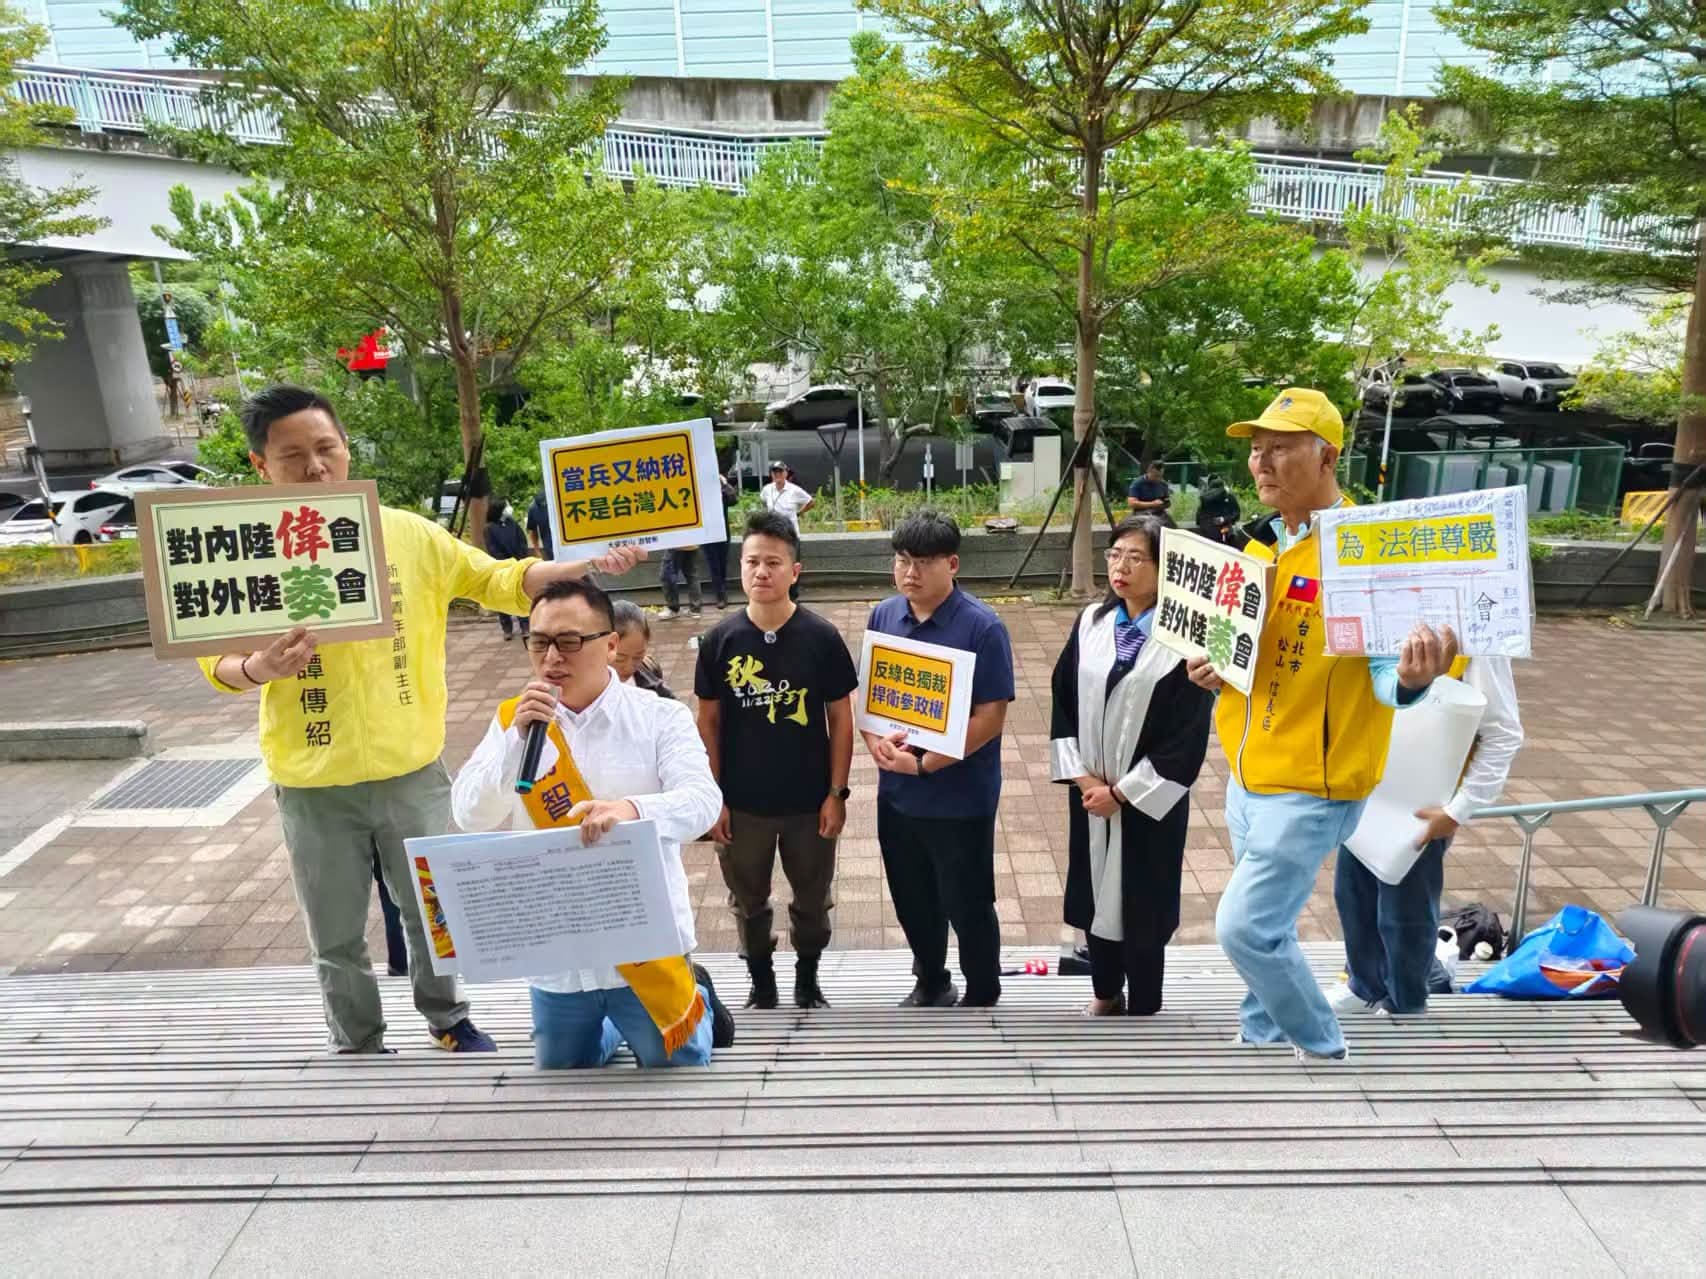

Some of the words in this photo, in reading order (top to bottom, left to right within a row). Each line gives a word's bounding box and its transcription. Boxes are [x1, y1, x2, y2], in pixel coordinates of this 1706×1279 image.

[562, 453, 687, 492] 當兵又納稅
[565, 488, 691, 523] 不是台灣人?
[166, 505, 361, 566] 對內陸偉會
[1338, 531, 1365, 560] 為
[1379, 521, 1497, 557] 法律尊嚴
[173, 564, 367, 621] 對外陸萎會
[1166, 549, 1262, 620] 對內陸偉會
[1158, 596, 1254, 673] 對外陸萎會
[874, 660, 947, 695] 反綠色獨裁
[871, 684, 945, 720] 捍衛參政權
